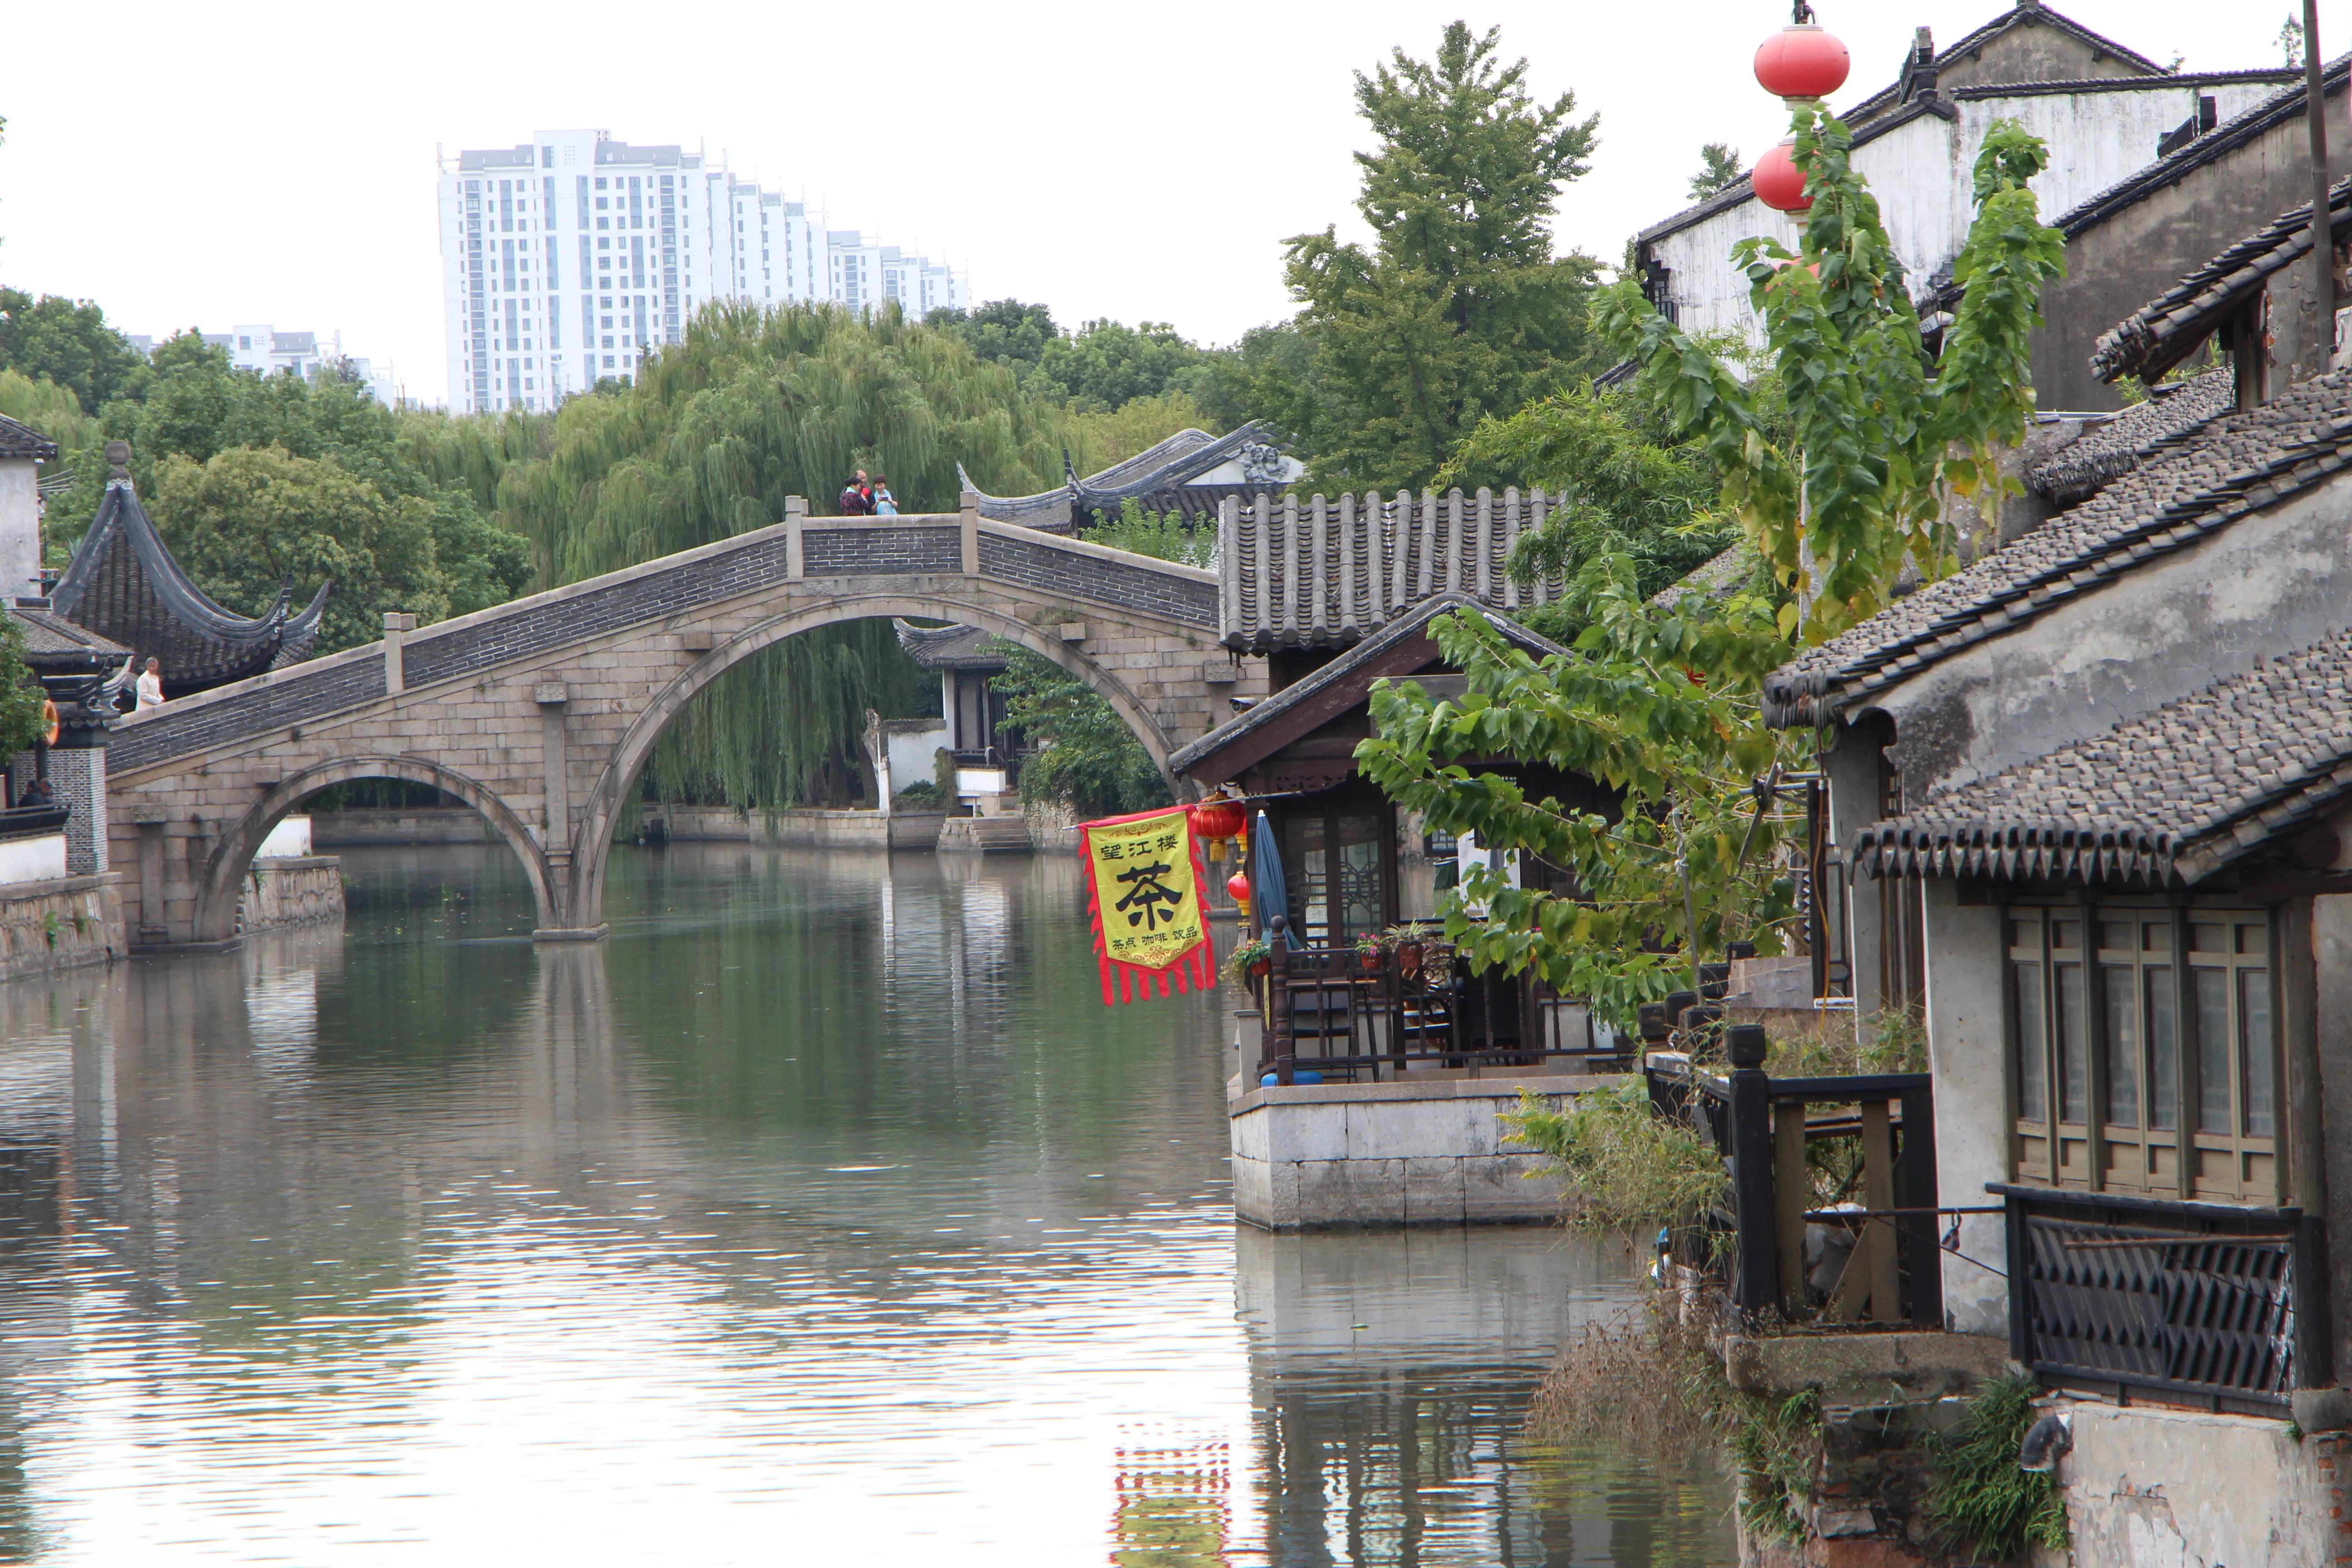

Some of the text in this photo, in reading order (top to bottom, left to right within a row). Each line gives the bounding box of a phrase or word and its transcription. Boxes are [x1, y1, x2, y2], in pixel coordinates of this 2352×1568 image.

[1100, 833, 1178, 860] 望江楼
[1115, 860, 1183, 931] 茶
[1112, 926, 1197, 951] 茶点 咖啡 饮品
